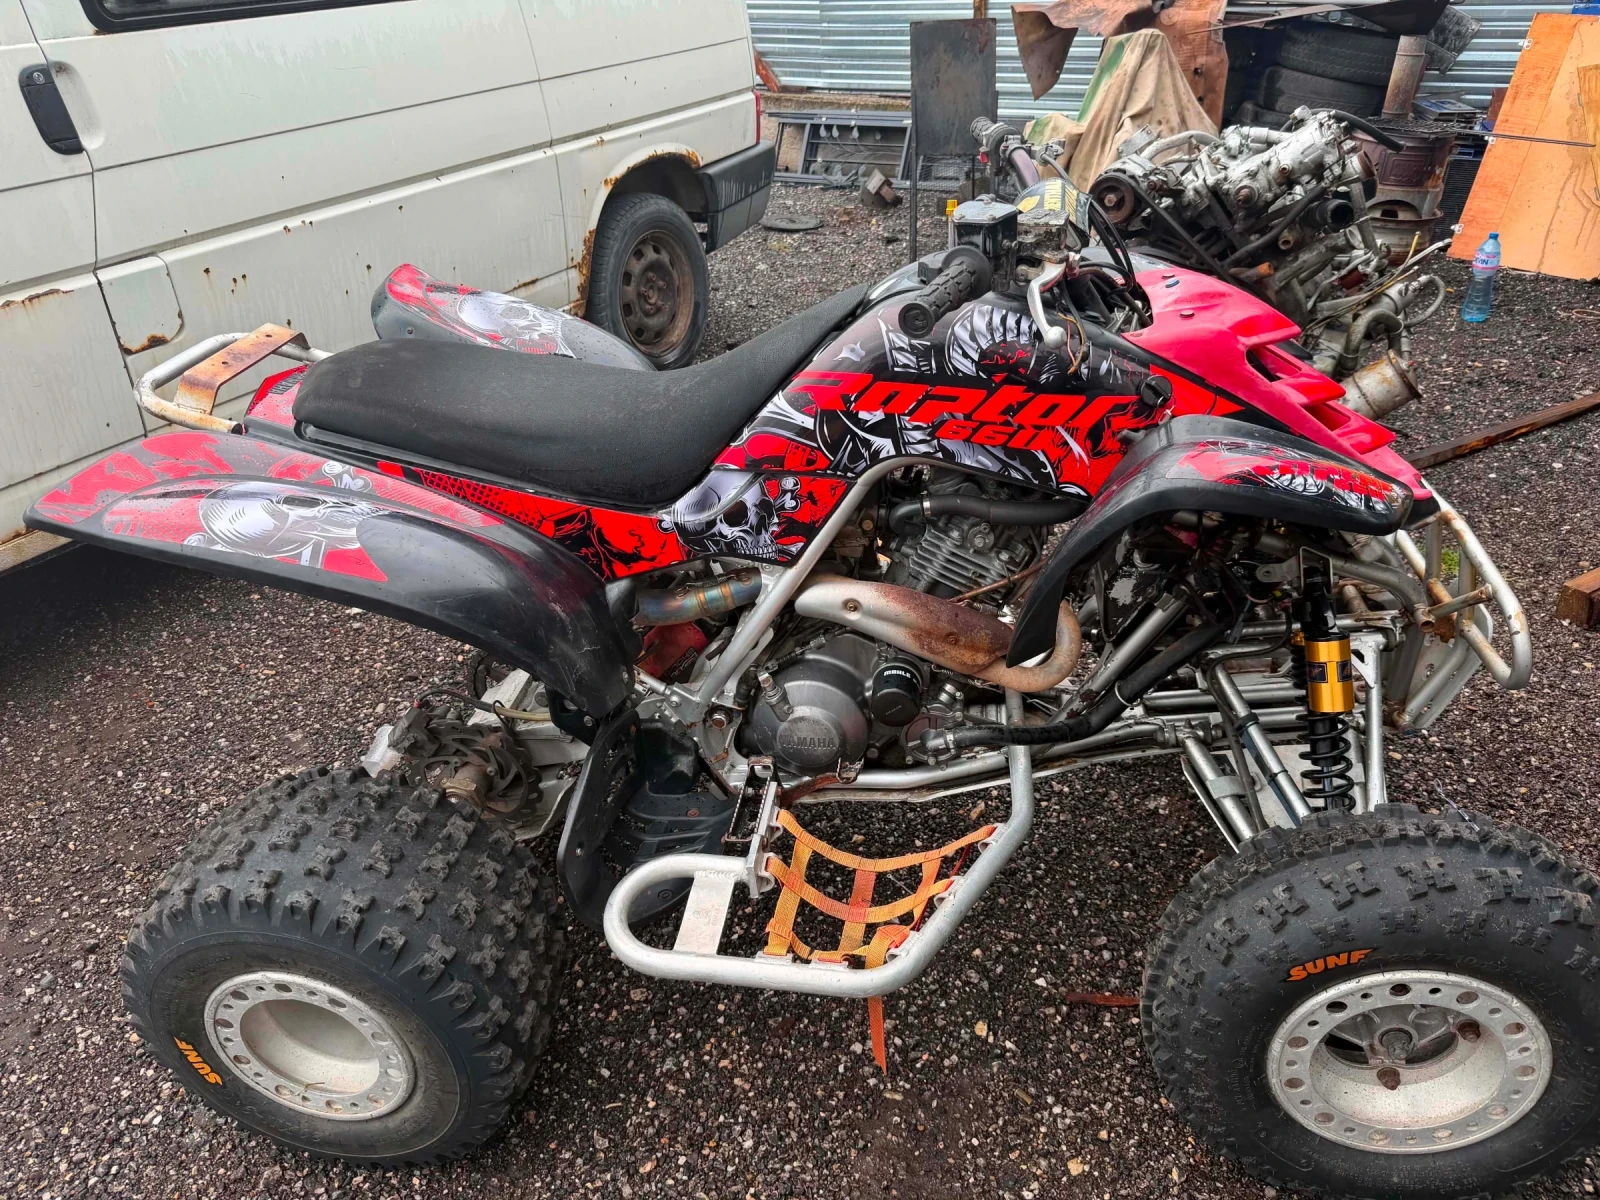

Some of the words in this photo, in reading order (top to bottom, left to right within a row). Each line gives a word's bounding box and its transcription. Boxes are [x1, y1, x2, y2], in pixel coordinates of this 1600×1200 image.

[883, 669, 911, 679] MAHLE
[778, 733, 836, 750] YAMAHA
[1286, 948, 1374, 982] SUNF
[173, 1036, 223, 1086] SUNF
